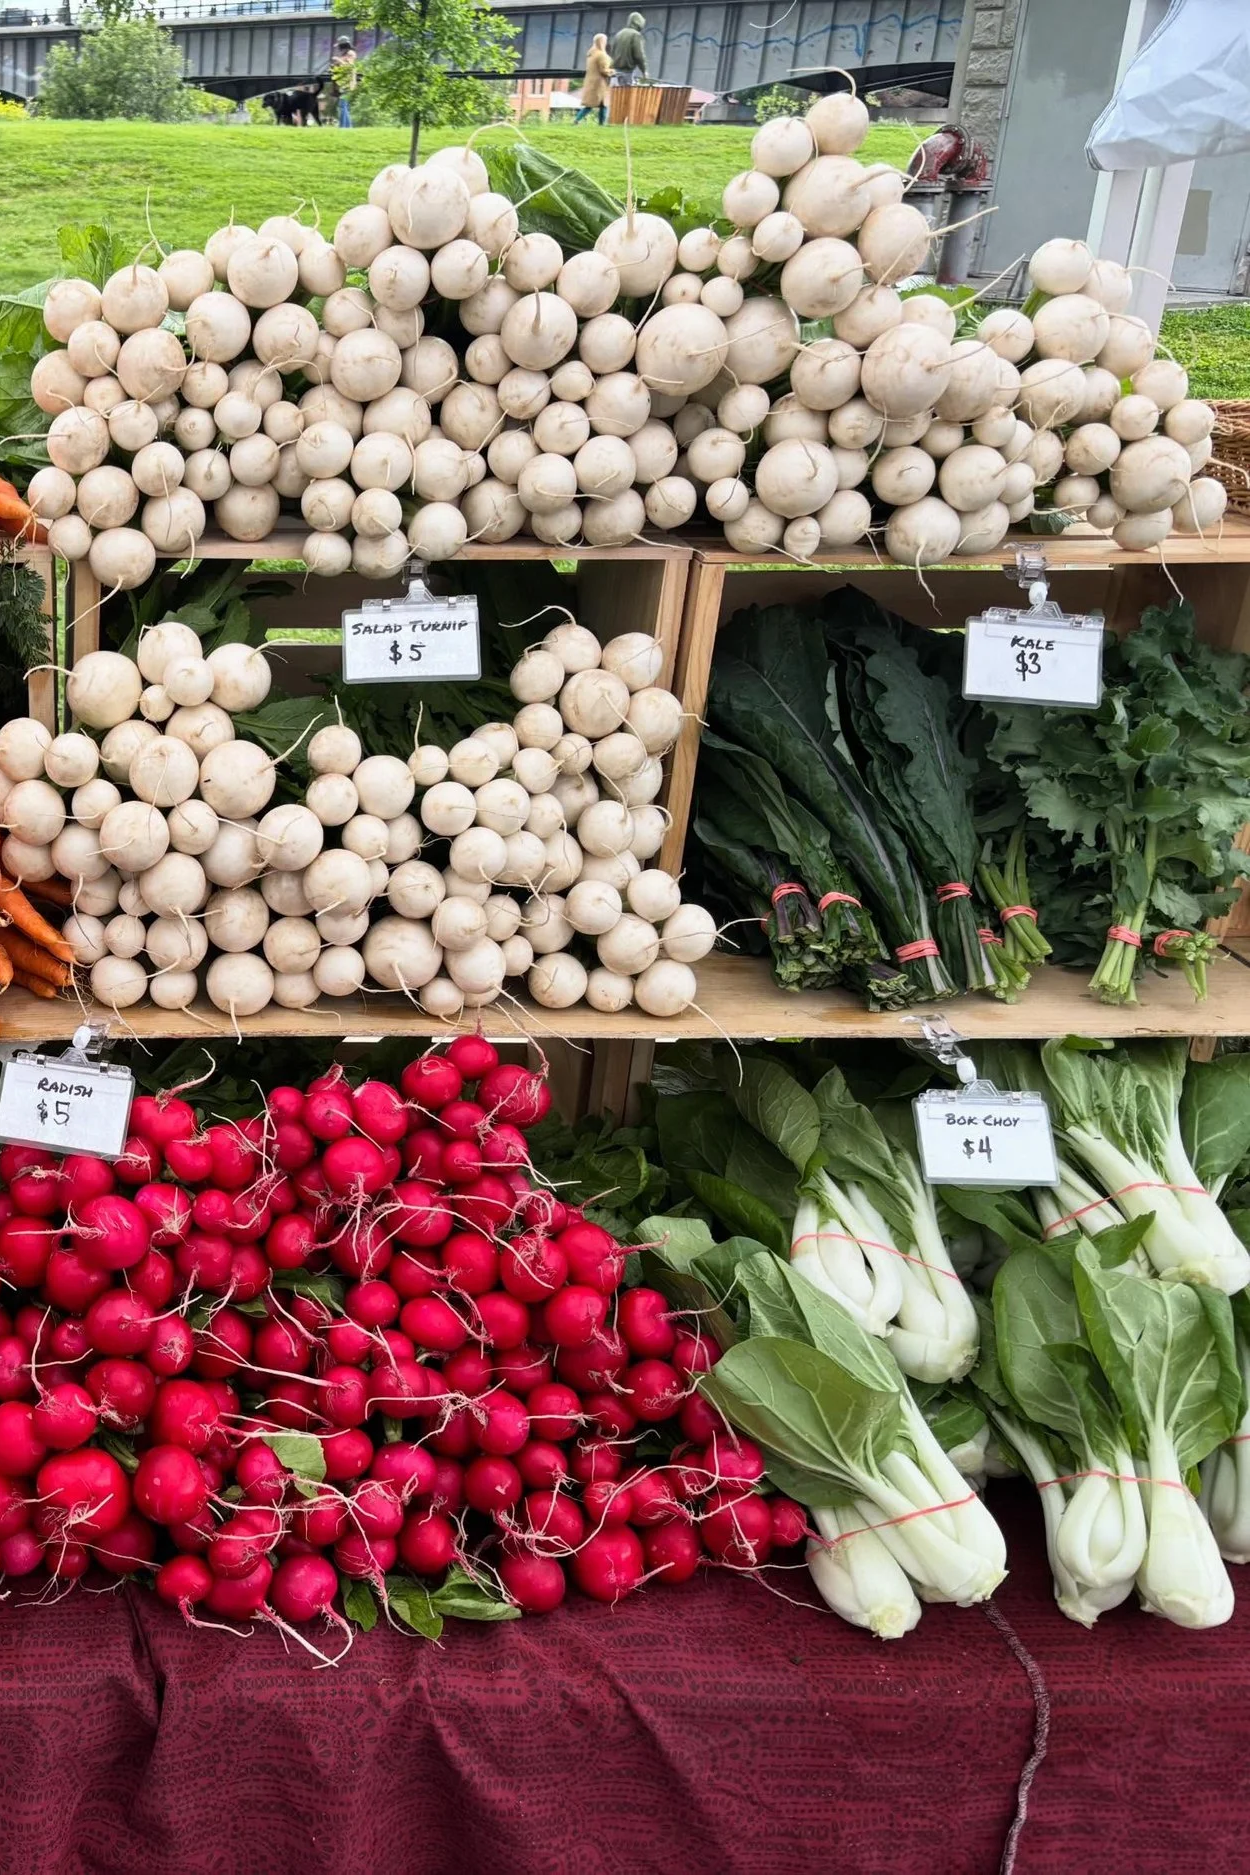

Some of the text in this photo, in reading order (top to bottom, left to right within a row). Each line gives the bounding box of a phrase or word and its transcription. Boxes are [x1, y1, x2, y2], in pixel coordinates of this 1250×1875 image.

[352, 619, 468, 635] SALAD TURNIP
[389, 640, 426, 665] $5
[1010, 635, 1055, 650] KALE
[1015, 650, 1041, 682] $3
[37, 1077, 93, 1098] RADISH
[36, 1098, 70, 1126] $5
[945, 1113, 1020, 1127] BOK CHOY
[962, 1135, 992, 1164] $4
